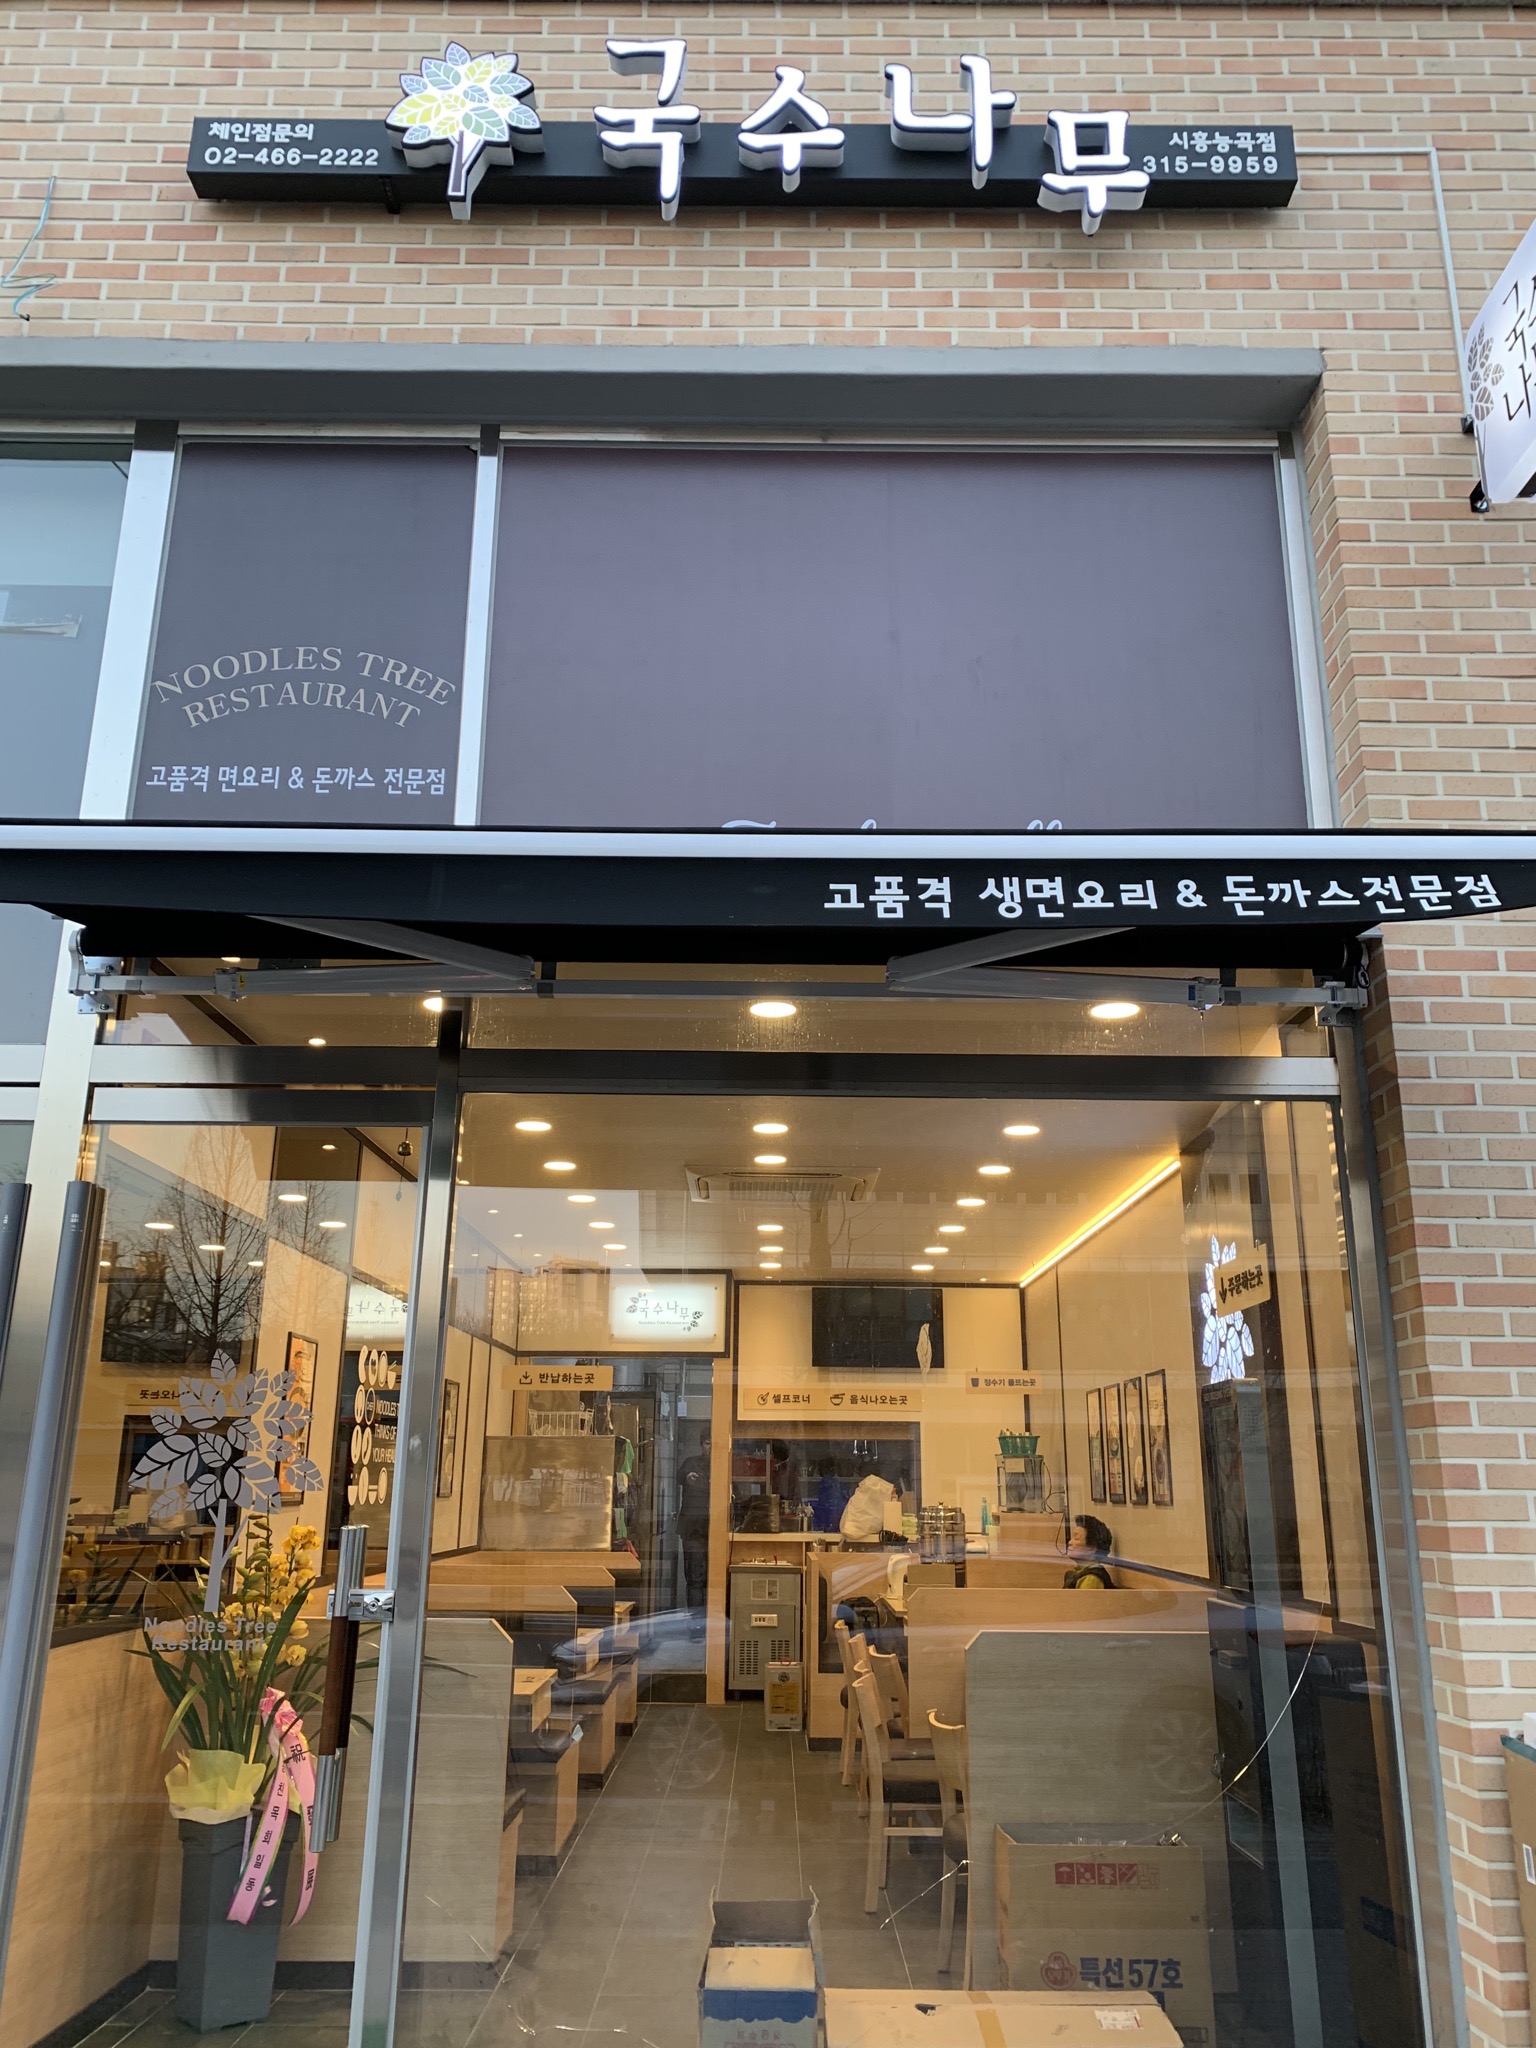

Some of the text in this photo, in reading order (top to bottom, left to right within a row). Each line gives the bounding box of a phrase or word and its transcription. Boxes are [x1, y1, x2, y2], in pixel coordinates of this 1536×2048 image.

[207, 121, 315, 143] 체인점문의
[593, 38, 1150, 222] 국수나무
[1168, 131, 1277, 153] 시흥능곡점
[204, 146, 379, 166] 02-466-2222
[1142, 155, 1278, 174] 315-9959
[151, 646, 456, 706] NOODLES TREE
[182, 681, 421, 728] RESTAURANT
[145, 765, 447, 795] 고품격 면요리 & 돈까스 전문점
[823, 876, 952, 918] 고품격
[978, 876, 1159, 918] 생면요리
[1176, 879, 1208, 908] &
[1227, 1263, 1264, 1298] 주문하는곳
[639, 1299, 689, 1320] 국수나무
[539, 1372, 595, 1384] 반납하는곳
[984, 1378, 1006, 1387] 정수기
[772, 1393, 909, 1405] 셀프코너 음식나오는곳
[143, 1616, 277, 1634] Noodles Tree
[151, 1635, 266, 1651] Restaurant
[1079, 1957, 1184, 1989] 특선57호
